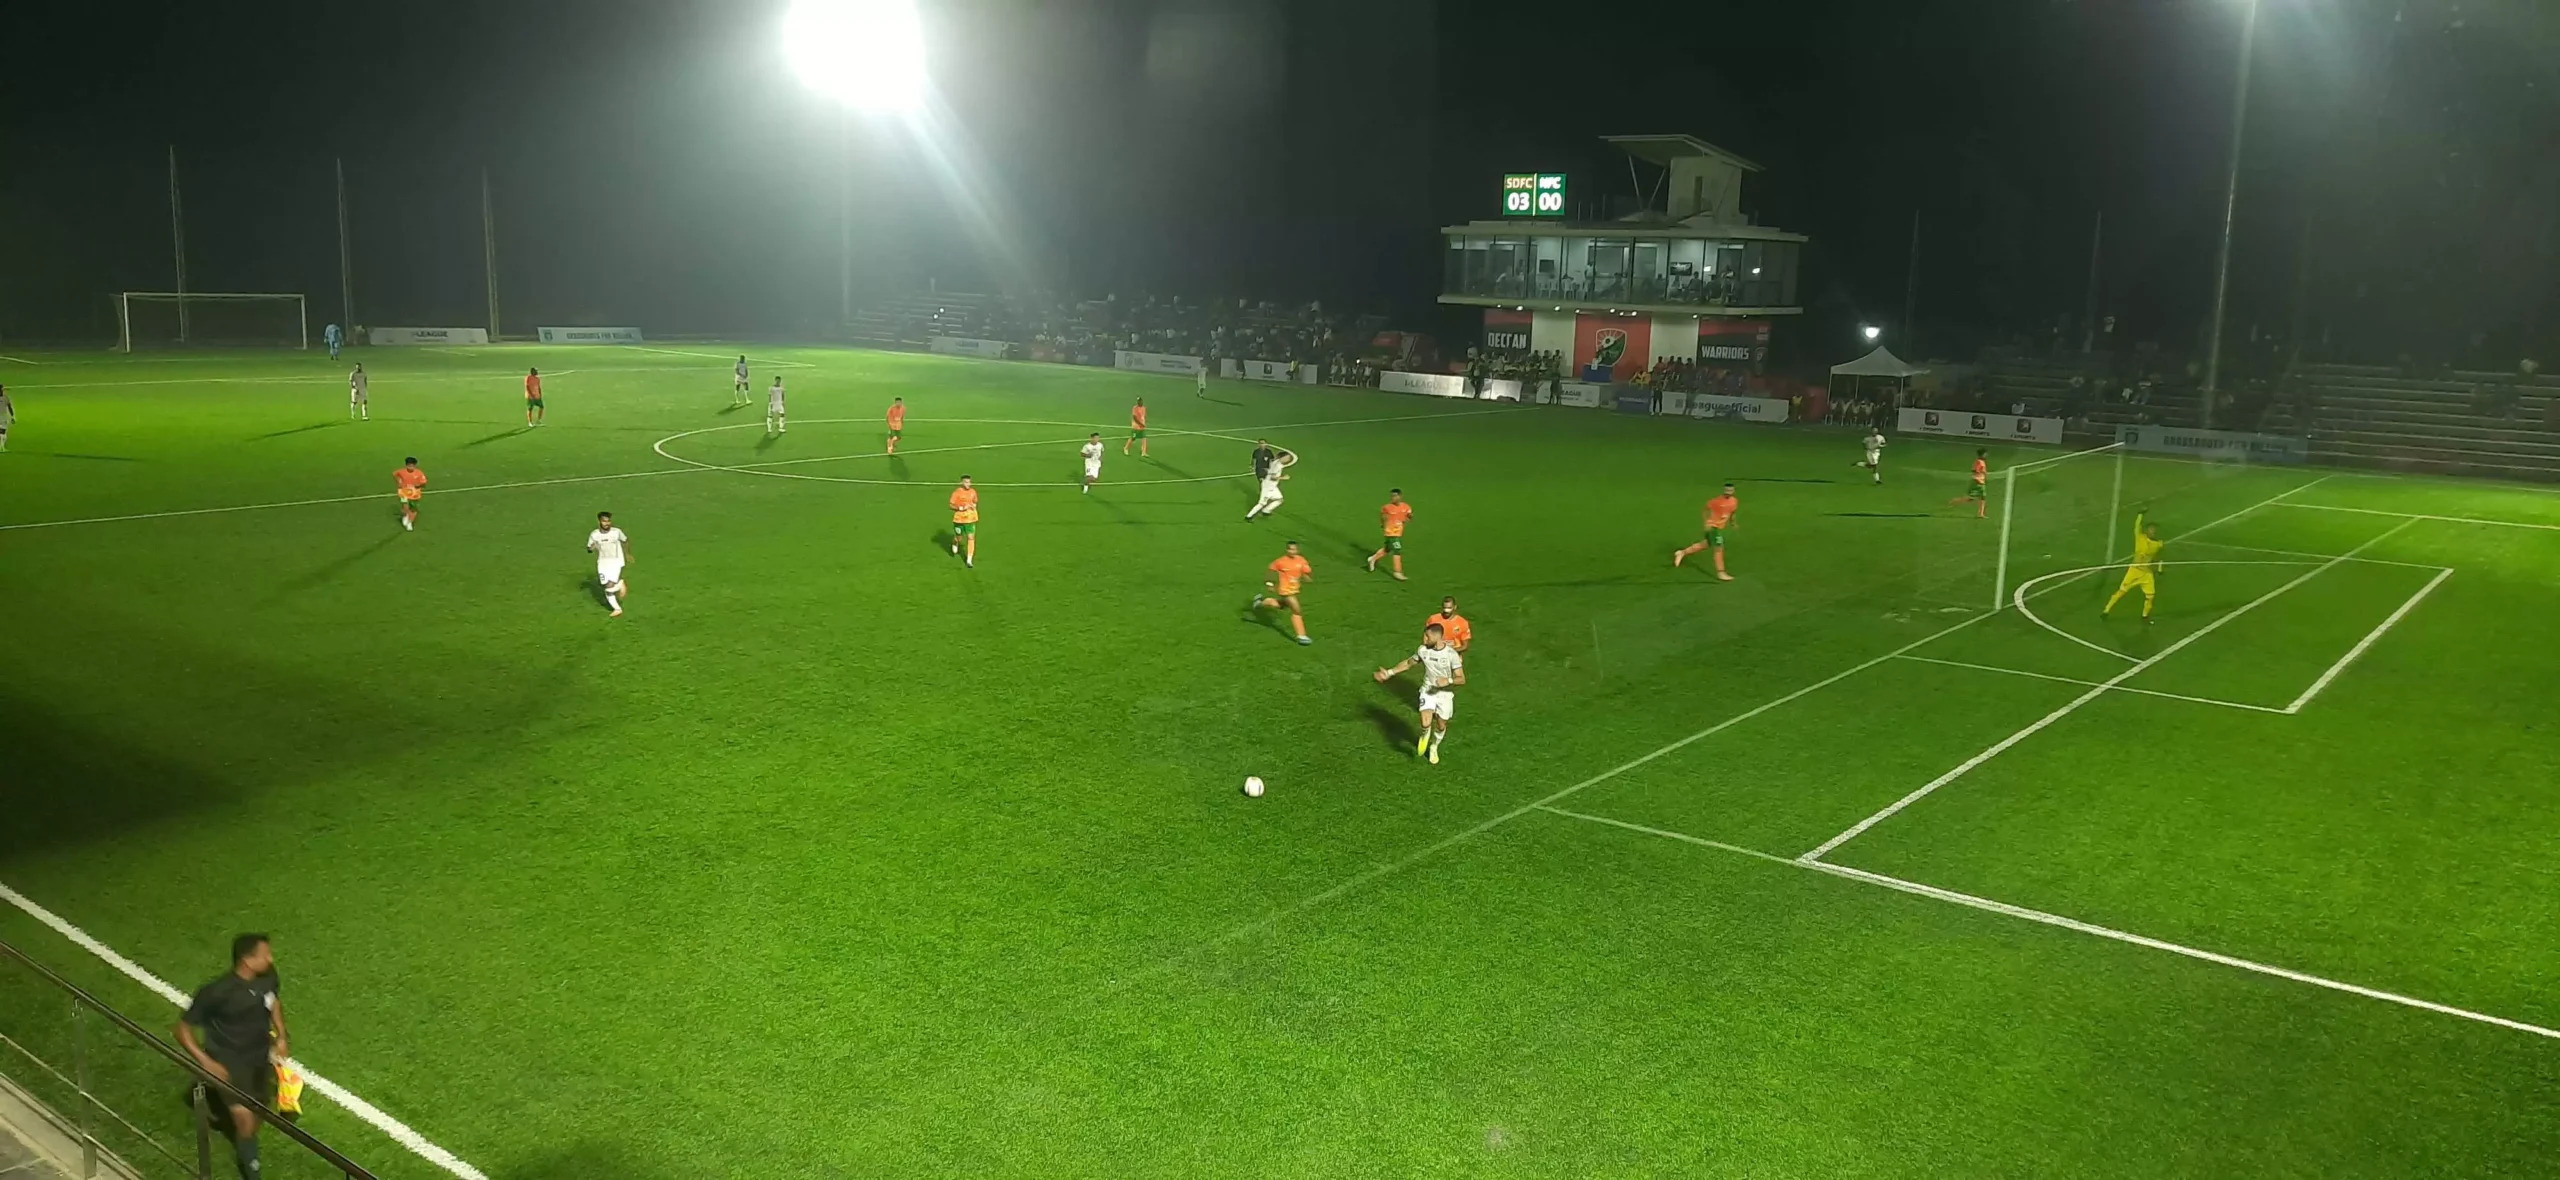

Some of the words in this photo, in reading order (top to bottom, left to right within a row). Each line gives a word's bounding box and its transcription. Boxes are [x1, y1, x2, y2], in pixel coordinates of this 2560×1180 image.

[1506, 177, 1533, 189] SDFC
[1507, 192, 1530, 211] 03
[1538, 192, 1562, 211] 00
[1487, 332, 1527, 349] DECCAN
[1701, 345, 1749, 360] WARRIORS
